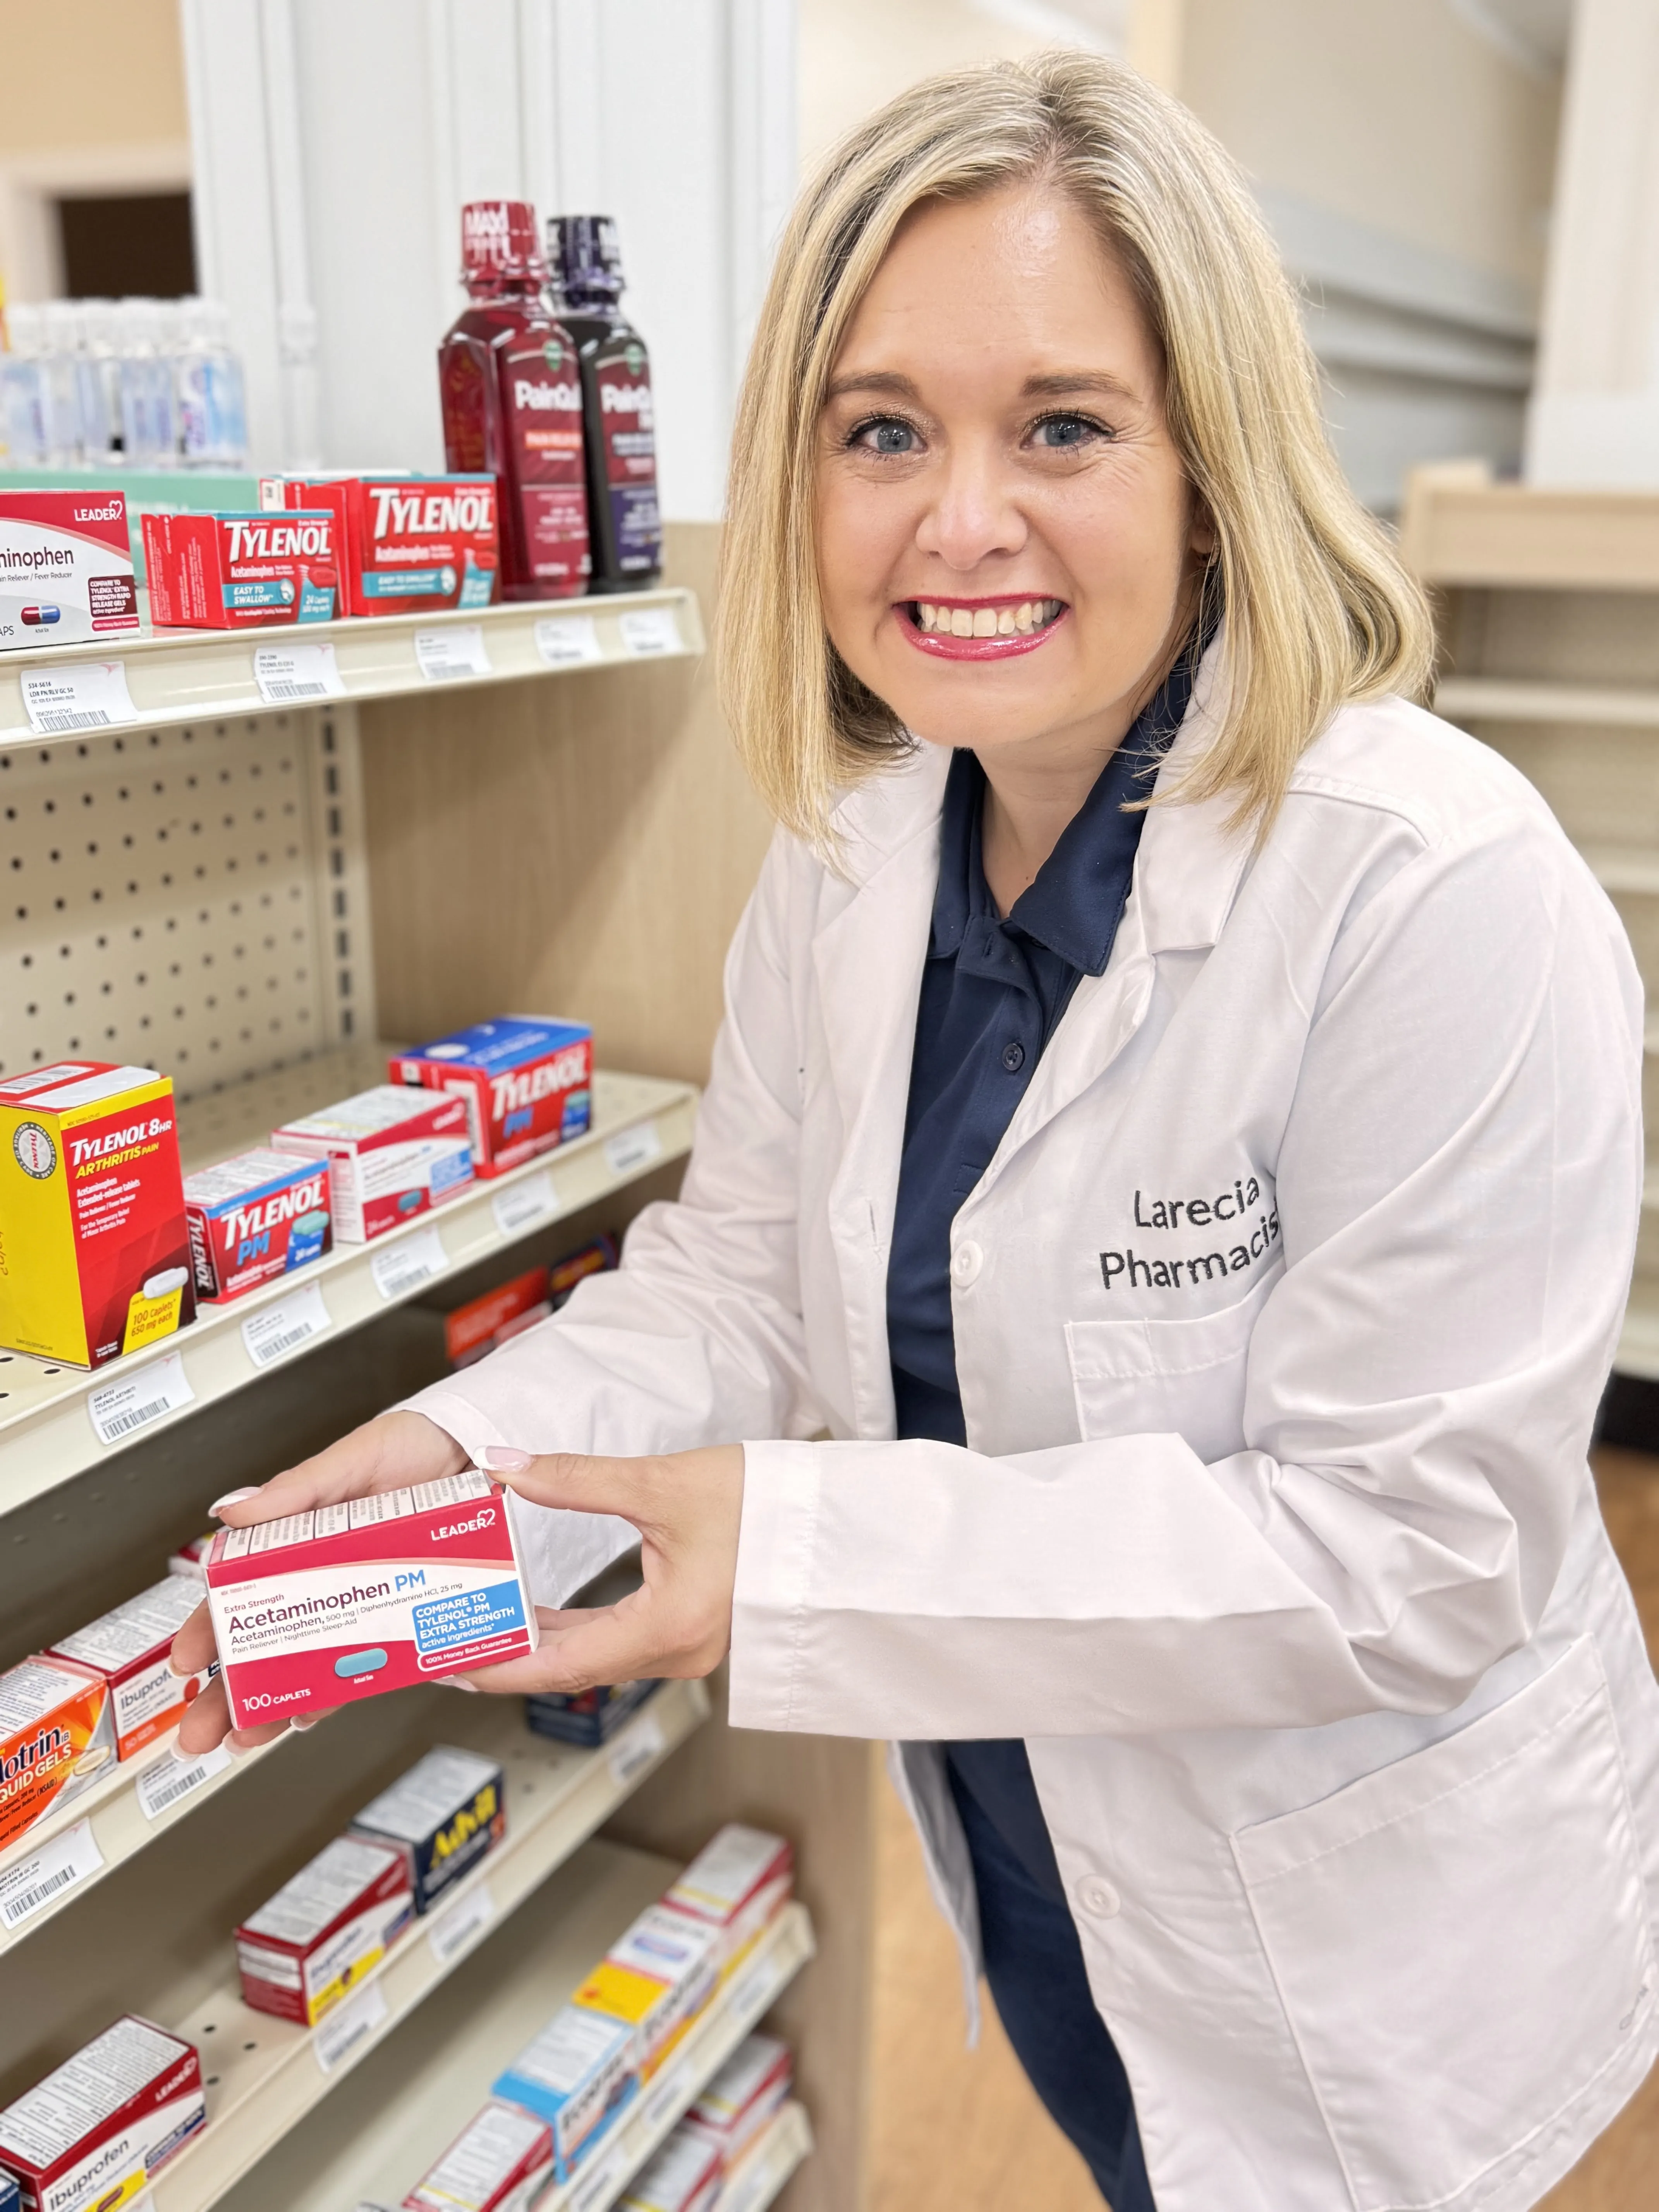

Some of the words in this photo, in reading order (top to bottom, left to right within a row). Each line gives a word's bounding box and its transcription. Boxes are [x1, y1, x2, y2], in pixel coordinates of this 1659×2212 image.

[74, 508, 117, 522] LEADER
[369, 488, 494, 540] TYLENOL
[224, 521, 331, 563] TYLENOL
[234, 587, 253, 595] EASY
[490, 1051, 589, 1120] TYLENOL
[69, 1123, 148, 1166] TYLENOL
[75, 1145, 141, 1180] ARTHRITIS
[141, 1142, 160, 1156] PAIN
[221, 1182, 325, 1250] TYLENOL
[1135, 1177, 1259, 1229] Larecia
[186, 1214, 210, 1288] TYLENOL
[237, 1230, 271, 1266] PM
[1099, 1197, 1278, 1290] Pharmacis
[131, 1324, 145, 1337] 650
[146, 1320, 156, 1331] mg
[158, 1311, 173, 1324] each
[133, 1310, 148, 1326] 100
[94, 1398, 115, 1410] TYLENOL
[431, 1517, 488, 1541] LEADER
[224, 1603, 246, 1614] Extra
[248, 1594, 285, 1608] Strength
[229, 1582, 390, 1634] Acetaminophen
[394, 1569, 426, 1592] PM
[232, 1616, 325, 1646] Acetaminophen,
[325, 1613, 341, 1622] 500
[343, 1609, 355, 1621] mg
[360, 1593, 423, 1614] Diphenhydramine
[440, 1585, 449, 1593] 25
[450, 1582, 463, 1591] mg
[416, 1596, 470, 1618] COMPARE
[470, 1592, 486, 1602] TO
[474, 1602, 490, 1614] PM
[232, 1646, 248, 1655] Pain
[249, 1638, 279, 1651] Reliever
[284, 1627, 321, 1642] Nighttime
[322, 1617, 357, 1632] Sleep-Aid
[419, 1624, 457, 1640] EXTRA
[458, 1606, 515, 1629] STRENGTH
[422, 1635, 446, 1649] active
[425, 1655, 442, 1665] 100%
[443, 1650, 464, 1661] Money
[465, 1645, 480, 1654] Back
[481, 1637, 512, 1650] Guarantee
[242, 1693, 271, 1712] 100
[273, 1688, 311, 1704] CAPLETS
[61, 1731, 70, 1743] IB
[35, 1743, 72, 1778] GELS
[37, 1776, 57, 1797] (NSAID)
[10, 1821, 21, 1834] Filled
[50, 2139, 129, 2210] Ibuprofen
